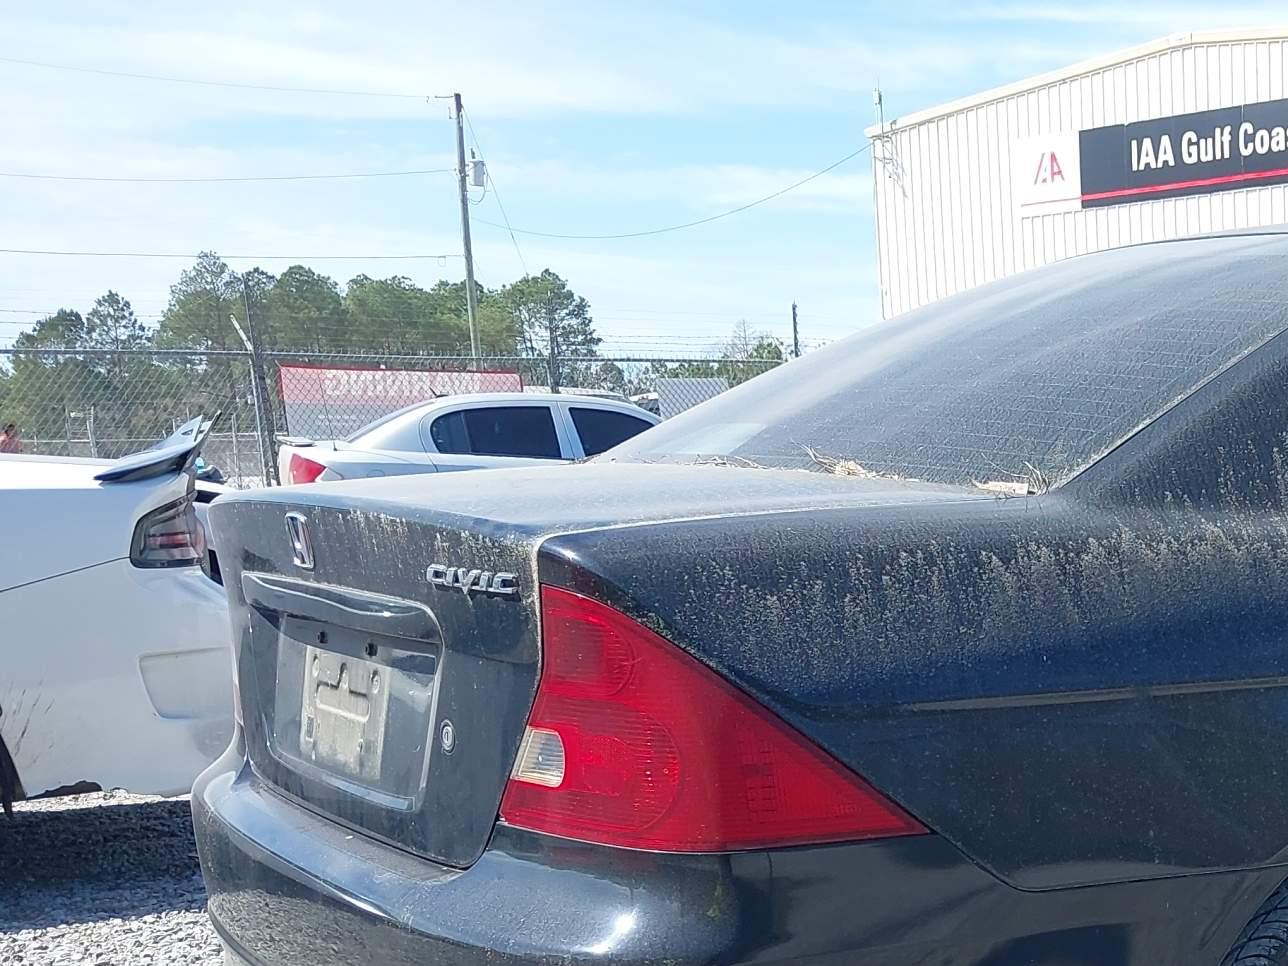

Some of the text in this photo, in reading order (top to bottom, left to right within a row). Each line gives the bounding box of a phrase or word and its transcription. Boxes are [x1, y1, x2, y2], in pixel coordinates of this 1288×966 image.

[1131, 134, 1175, 171] IAA
[1181, 125, 1232, 164] Gulf
[426, 564, 520, 598] CIVIC
